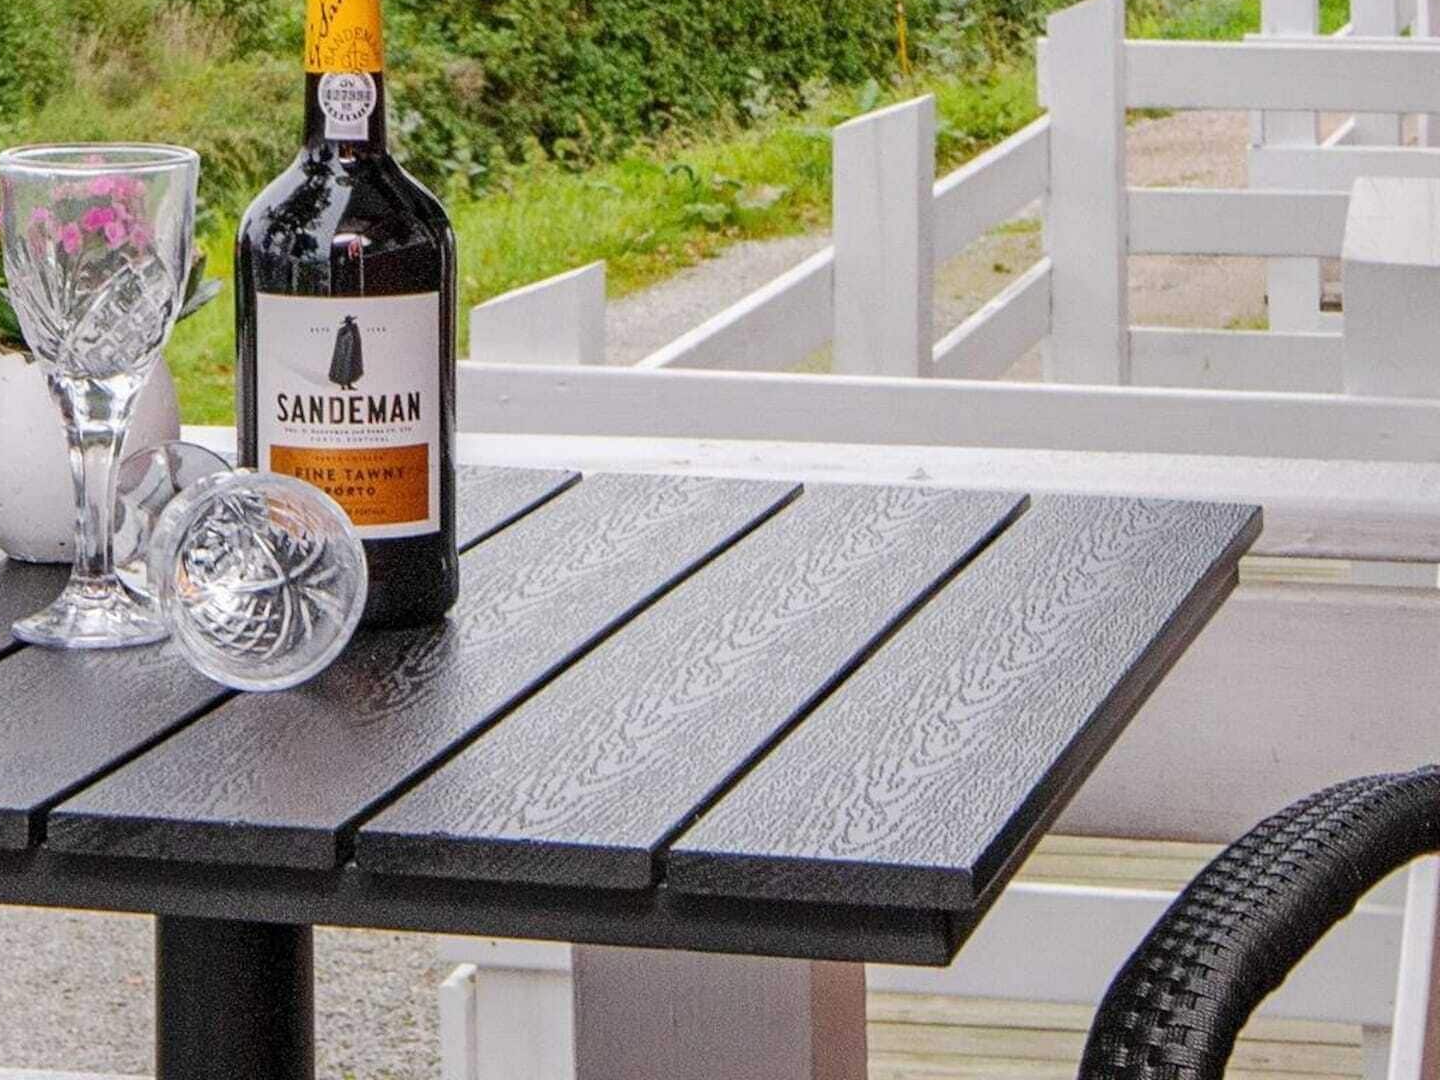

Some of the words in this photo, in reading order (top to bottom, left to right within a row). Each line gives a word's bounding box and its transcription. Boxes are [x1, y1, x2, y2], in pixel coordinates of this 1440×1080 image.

[277, 392, 421, 424] SANDEMAN
[294, 466, 336, 482] FINE
[341, 466, 406, 481] TAWNY
